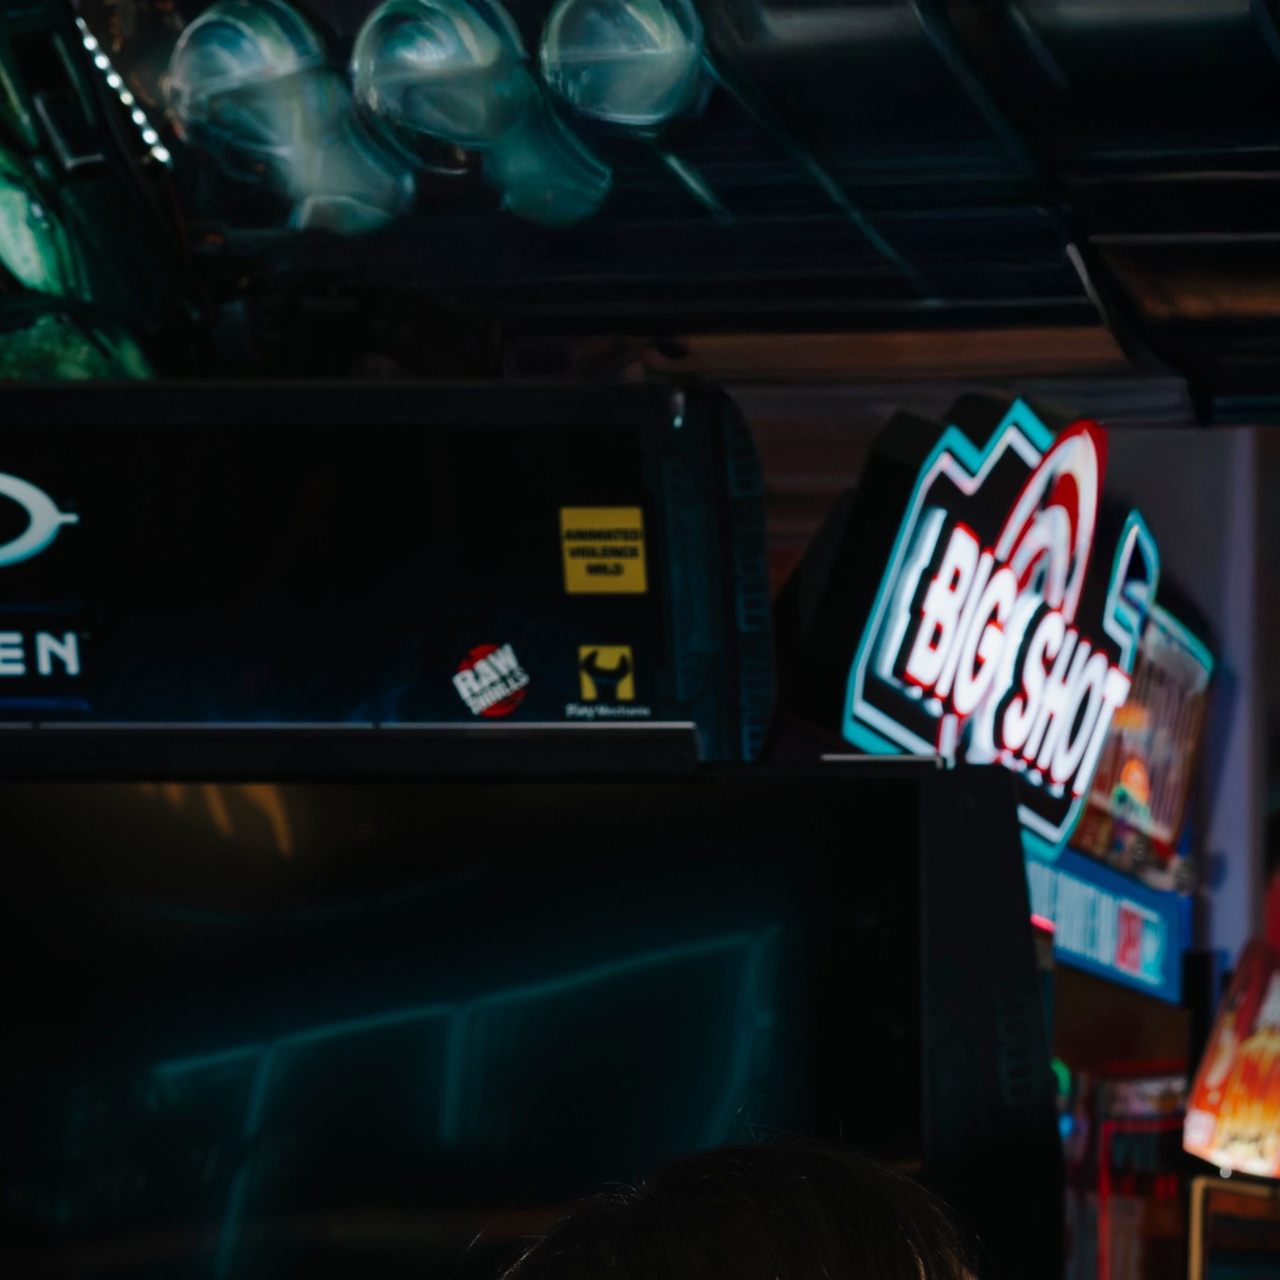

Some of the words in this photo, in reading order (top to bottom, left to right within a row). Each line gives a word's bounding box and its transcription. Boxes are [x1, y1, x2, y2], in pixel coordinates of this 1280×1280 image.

[565, 529, 644, 541] ANIMATED
[570, 546, 639, 558] VIOLENCE
[586, 563, 623, 576] MILD
[904, 521, 1018, 718] BIG
[1001, 607, 1131, 799] SHOT
[452, 642, 519, 700] RAW
